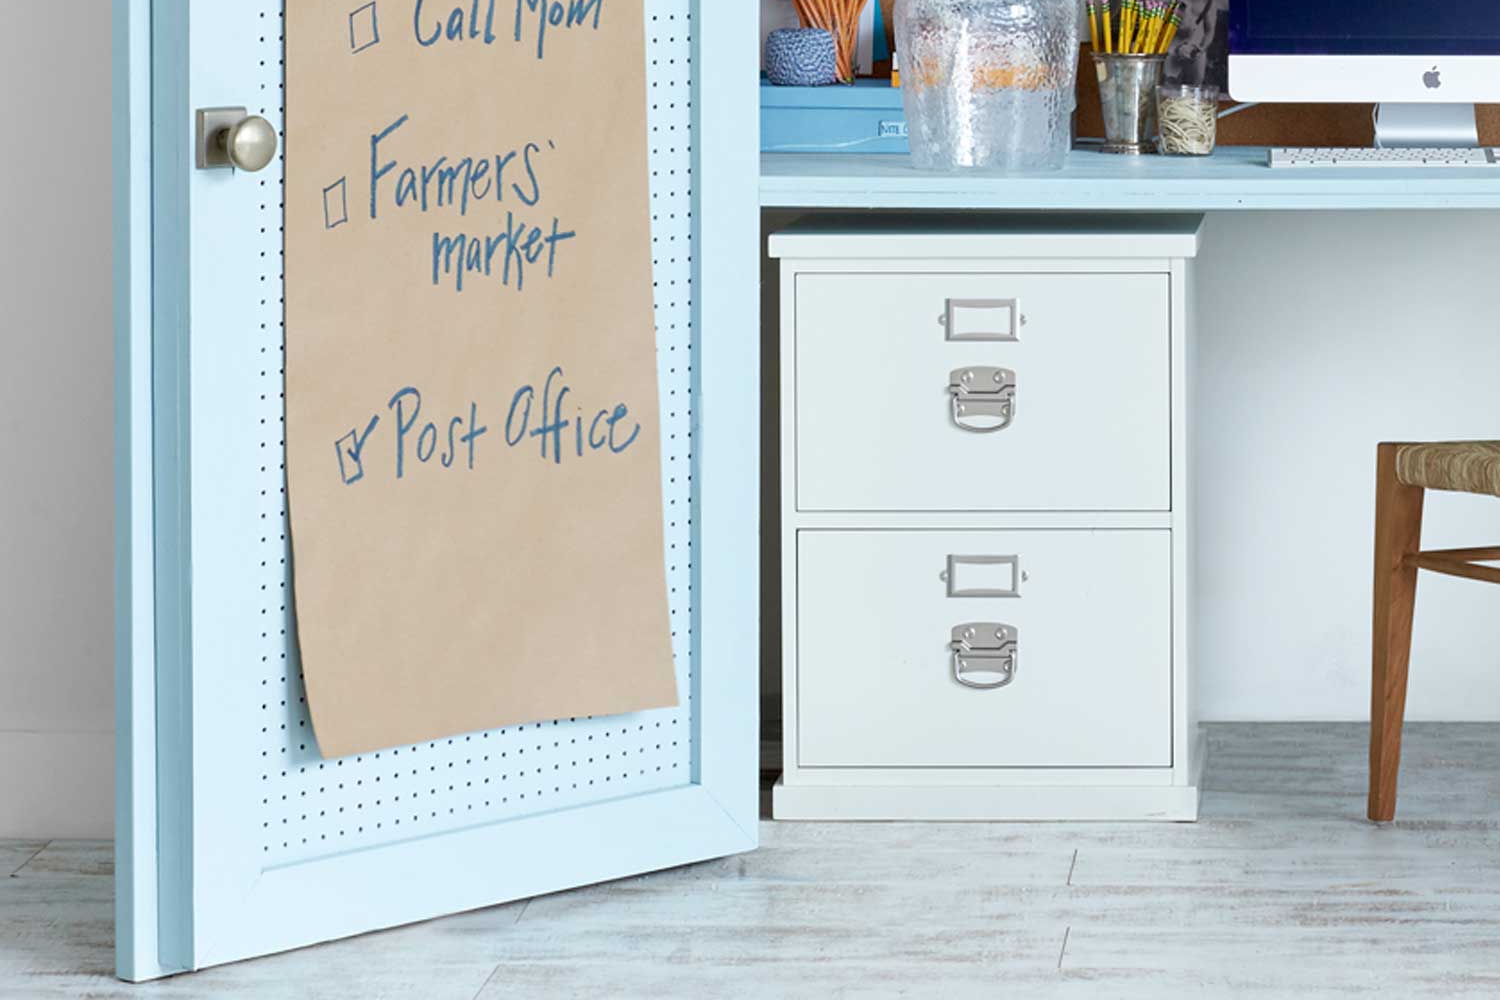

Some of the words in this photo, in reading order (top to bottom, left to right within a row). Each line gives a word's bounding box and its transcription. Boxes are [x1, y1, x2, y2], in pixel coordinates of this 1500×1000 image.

[370, 114, 555, 219] Farmers'
[432, 211, 576, 292] market
[389, 386, 487, 479] Post
[505, 366, 641, 464] Office
